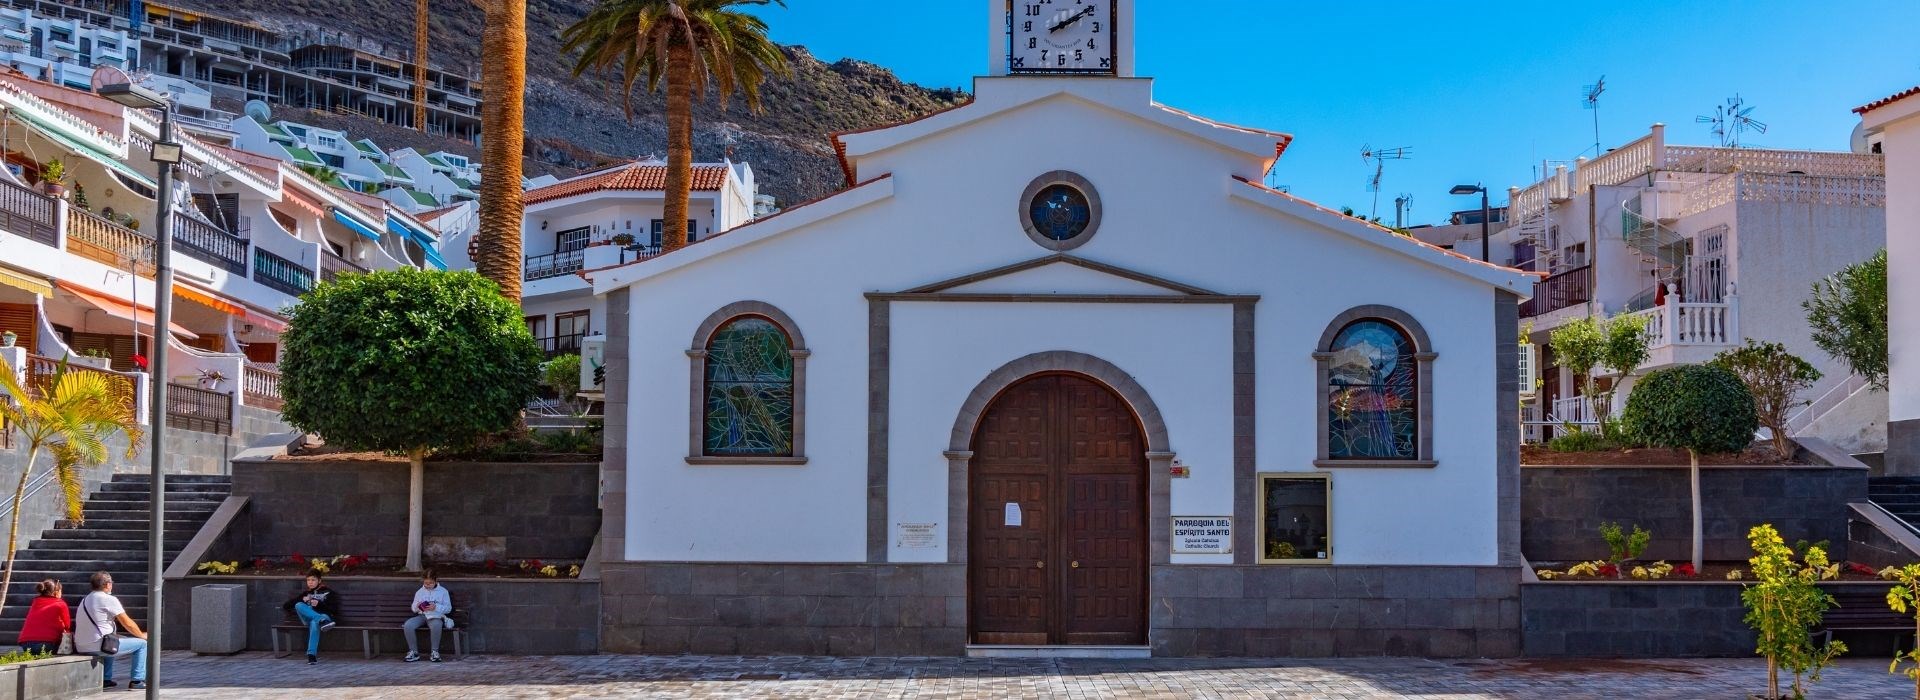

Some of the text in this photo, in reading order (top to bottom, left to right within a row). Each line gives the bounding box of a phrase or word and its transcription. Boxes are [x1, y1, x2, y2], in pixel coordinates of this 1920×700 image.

[1025, 4, 1040, 16] 10
[1087, 5, 1095, 16] 2
[1024, 20, 1032, 32] 9
[1092, 21, 1100, 33] 3
[1029, 37, 1037, 49] 8
[1087, 38, 1095, 49] 4
[1041, 50, 1048, 61] 7
[1058, 55, 1065, 65] 6
[1075, 49, 1082, 61] 5
